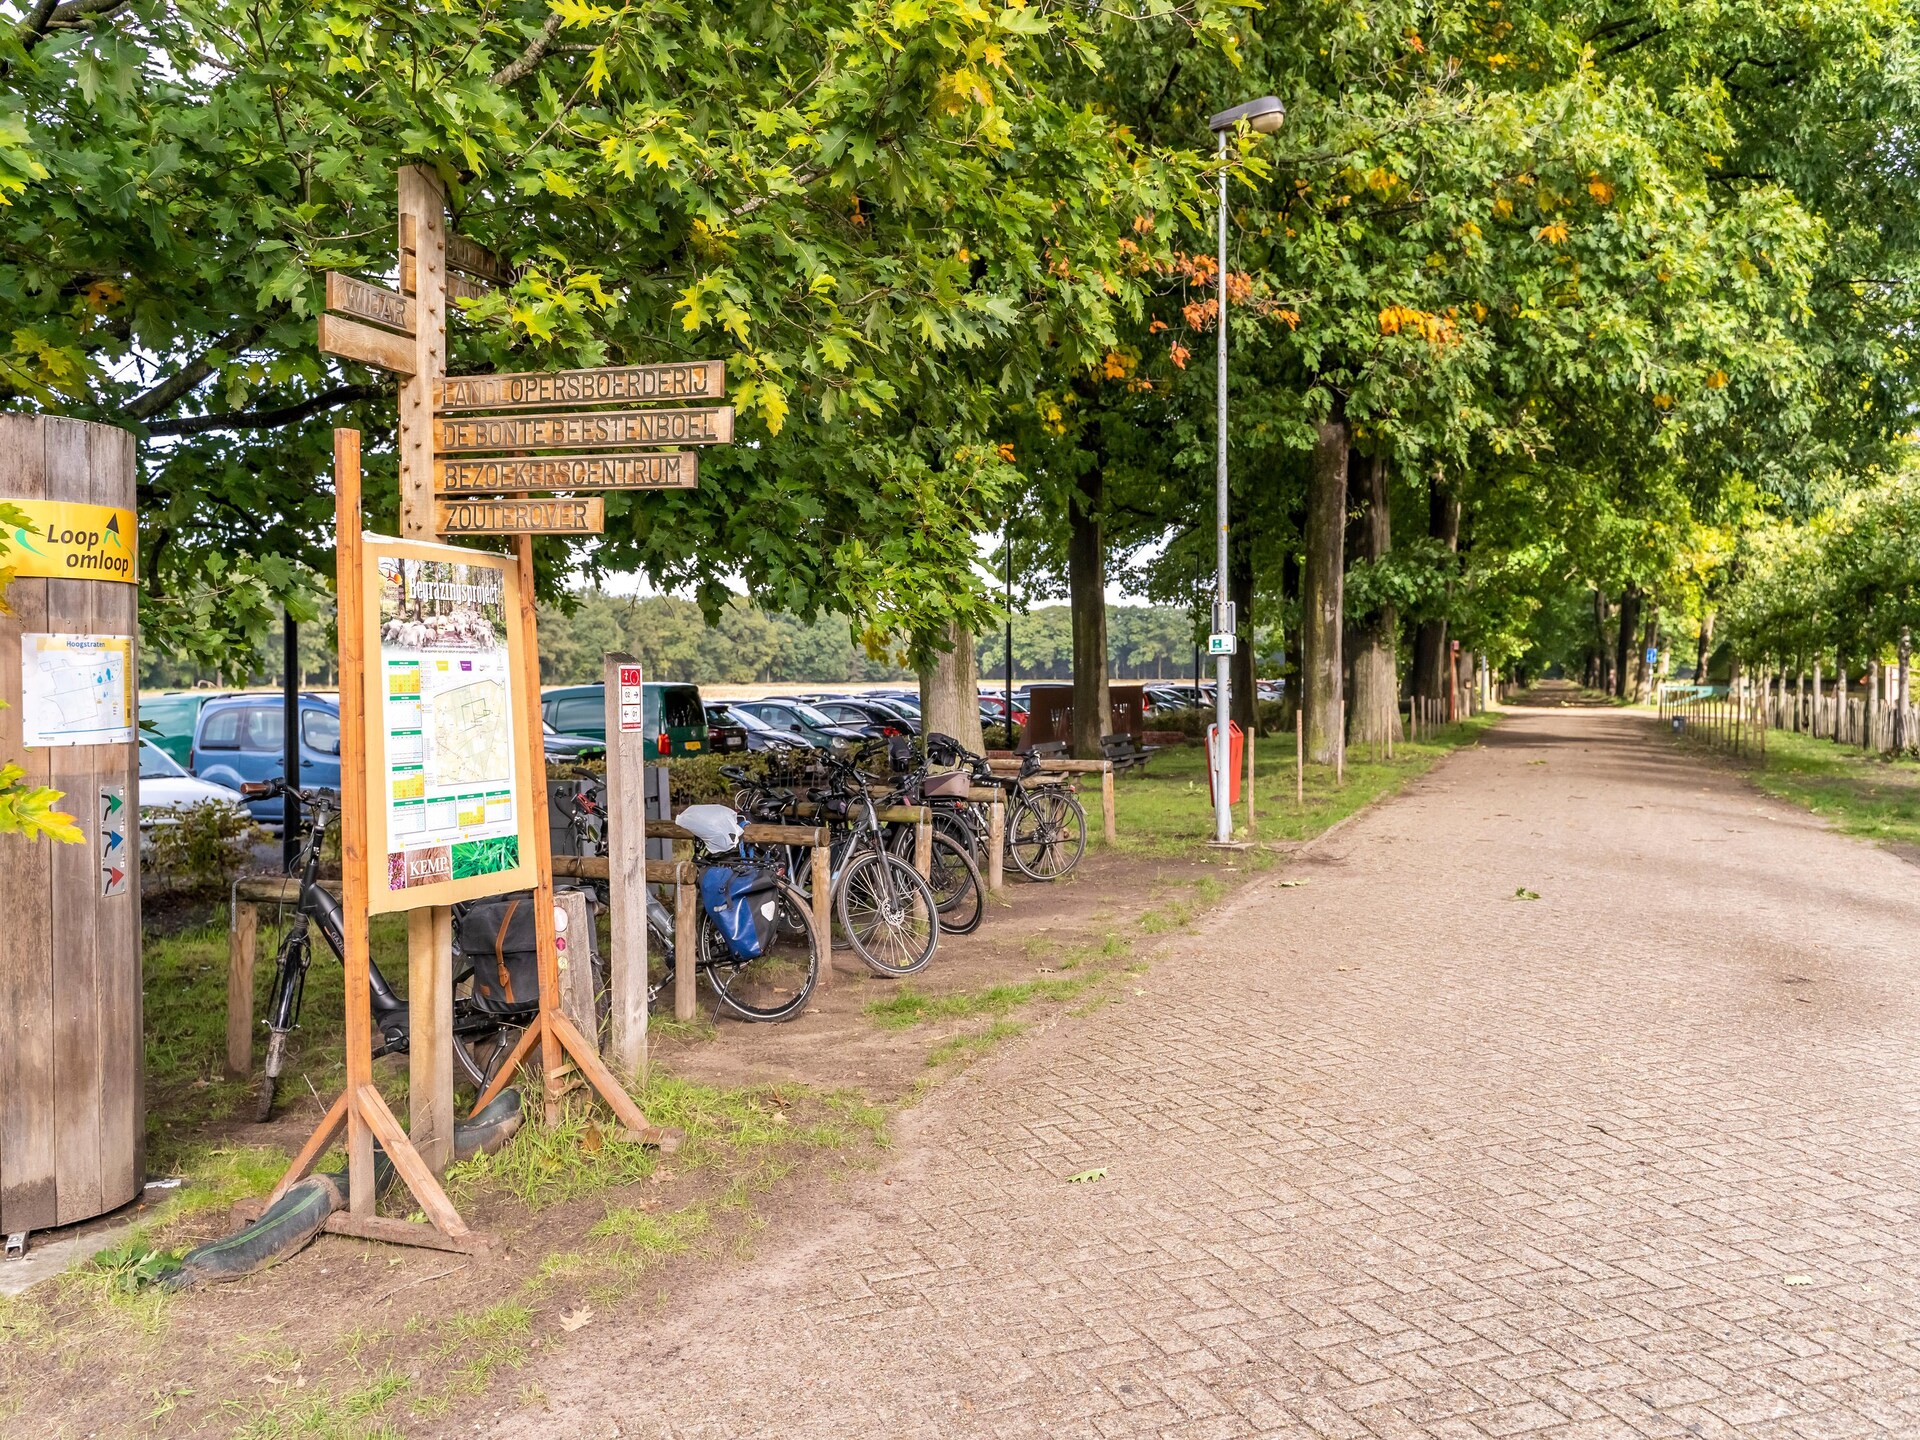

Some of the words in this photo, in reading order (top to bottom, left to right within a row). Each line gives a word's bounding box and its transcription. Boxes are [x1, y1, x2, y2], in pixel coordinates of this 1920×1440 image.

[442, 365, 708, 407] LANDLOPERSBOERDERIJ
[444, 422, 469, 447] DE
[476, 420, 546, 446] BONTE
[553, 412, 718, 444] BEESTENBOEL
[445, 456, 682, 490] BEZOEKERSCENTRUM
[445, 502, 588, 530] ZOUTEROVER
[47, 524, 99, 551] Loop
[66, 549, 129, 577] omloop
[409, 576, 499, 606] Begrazingsproject
[66, 640, 106, 649] Hoogstraten
